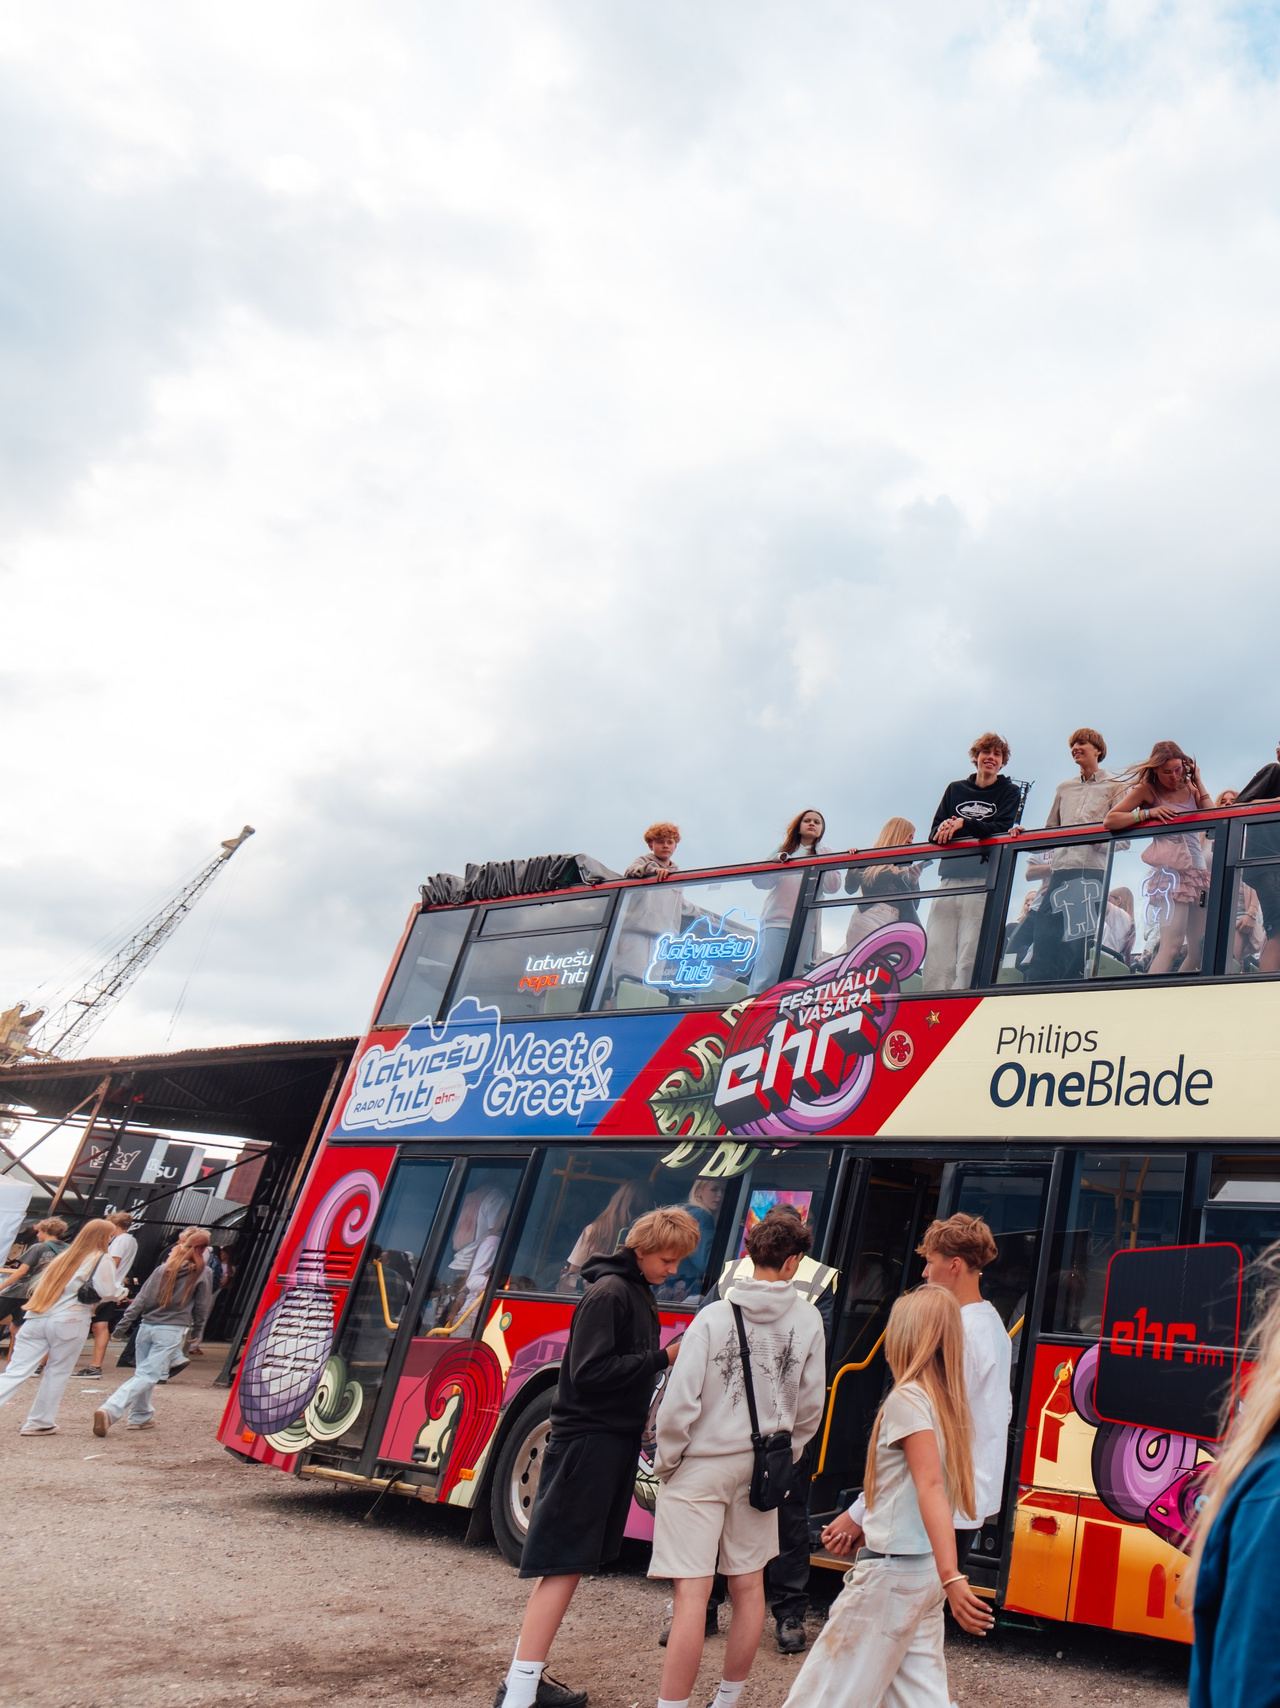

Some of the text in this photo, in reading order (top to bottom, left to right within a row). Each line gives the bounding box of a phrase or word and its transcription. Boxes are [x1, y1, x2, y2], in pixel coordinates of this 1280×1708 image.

[518, 973, 559, 993] repa
[778, 966, 880, 1015] FESTIVĀLU
[799, 990, 872, 1027] VASARA
[714, 1011, 863, 1107] ehr
[996, 1024, 1099, 1059] Philips
[495, 1033, 613, 1100] Meet &
[989, 1054, 1213, 1108] OneBlade
[353, 1097, 386, 1114] RADIO
[484, 1073, 590, 1116] Greet
[1110, 1307, 1224, 1367] ehr.fm
